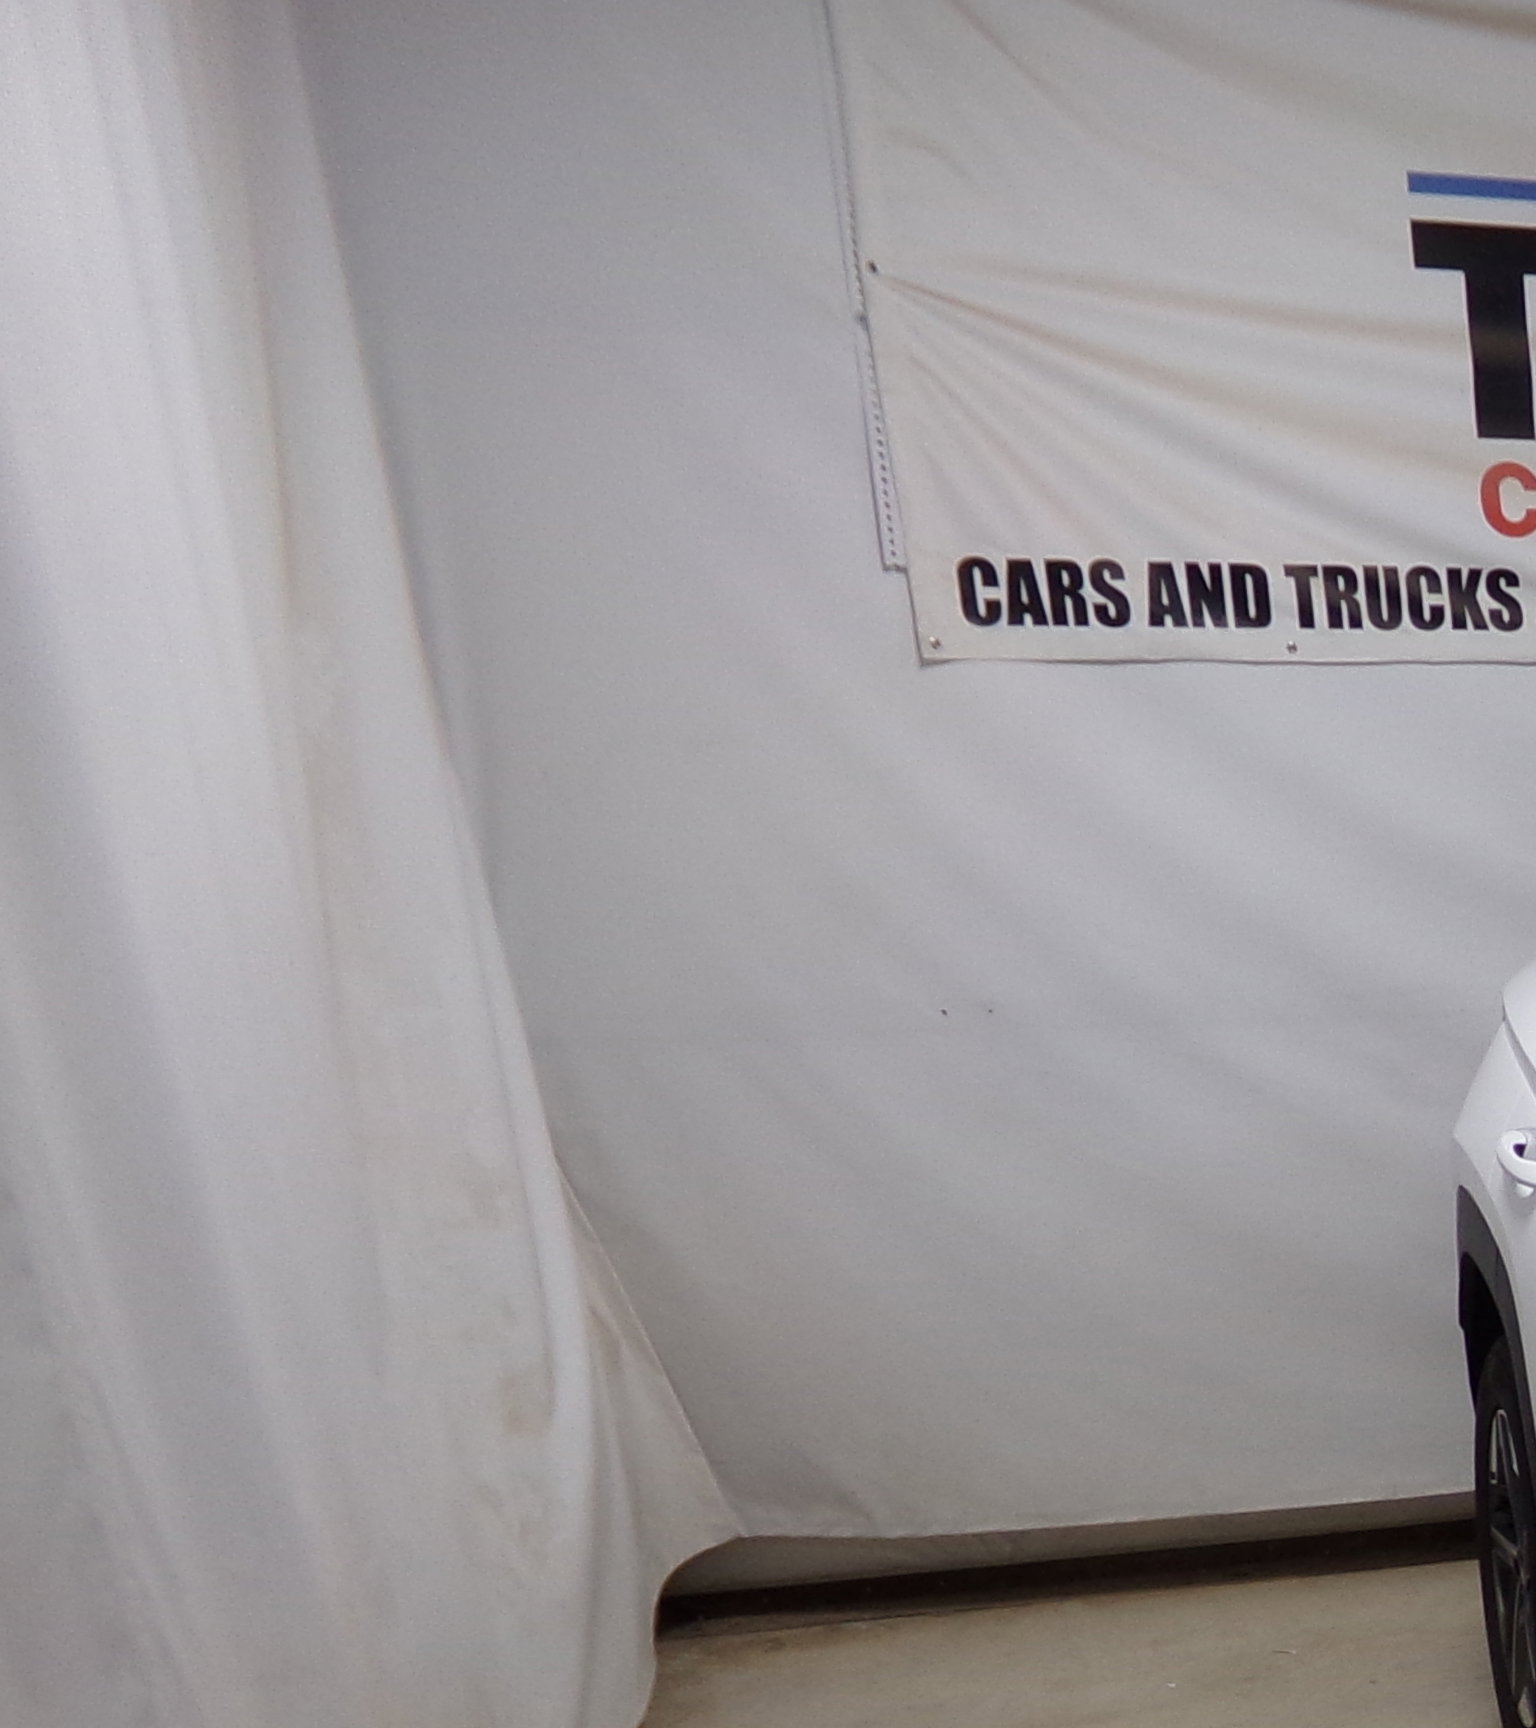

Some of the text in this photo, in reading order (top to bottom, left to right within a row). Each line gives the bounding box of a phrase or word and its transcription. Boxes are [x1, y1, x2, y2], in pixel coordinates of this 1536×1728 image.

[956, 555, 1131, 629] CARS
[1147, 561, 1272, 630] AND
[1285, 563, 1524, 632] TRUCKS
